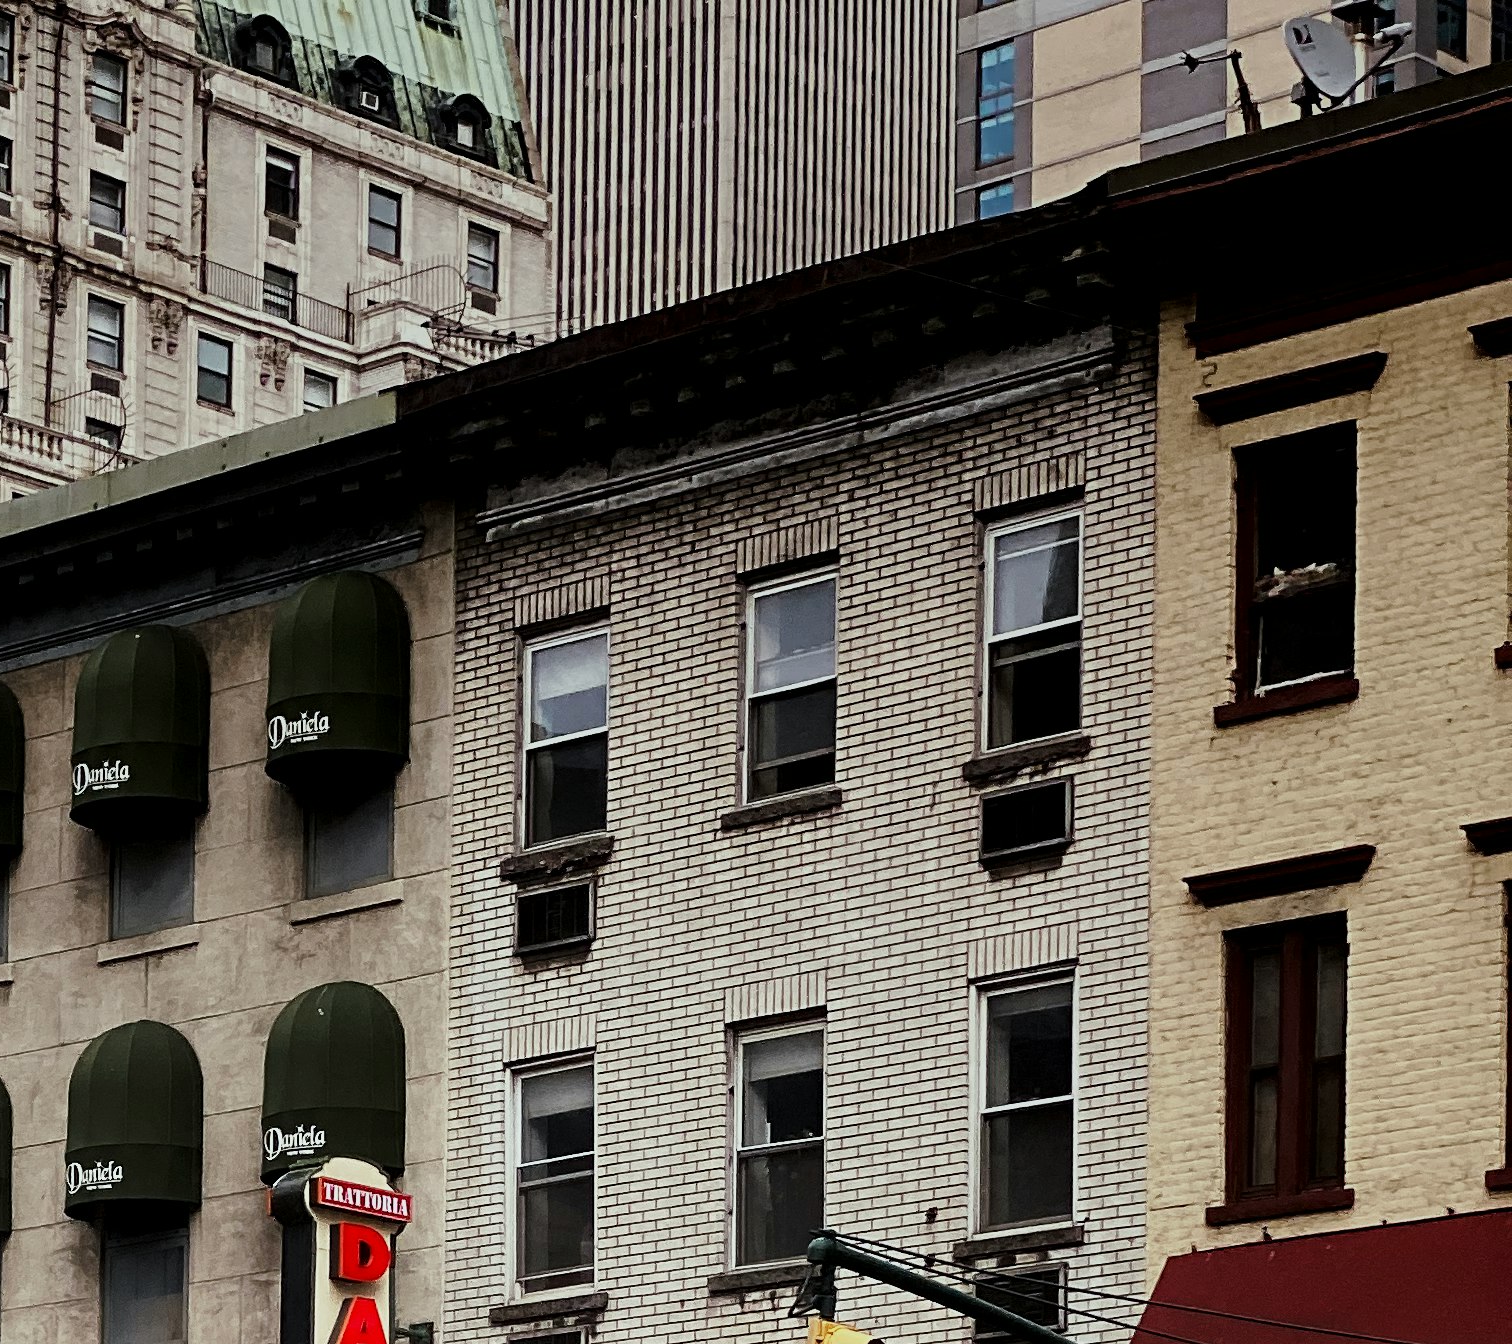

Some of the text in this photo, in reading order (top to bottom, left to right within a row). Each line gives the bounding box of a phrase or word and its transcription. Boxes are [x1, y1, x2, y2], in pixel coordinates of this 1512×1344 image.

[269, 711, 330, 749] Daniela
[73, 759, 130, 795] Daniela
[264, 1124, 325, 1160] Daniela
[66, 1161, 123, 1194] Daniela
[323, 1182, 408, 1216] TRATTORIA
